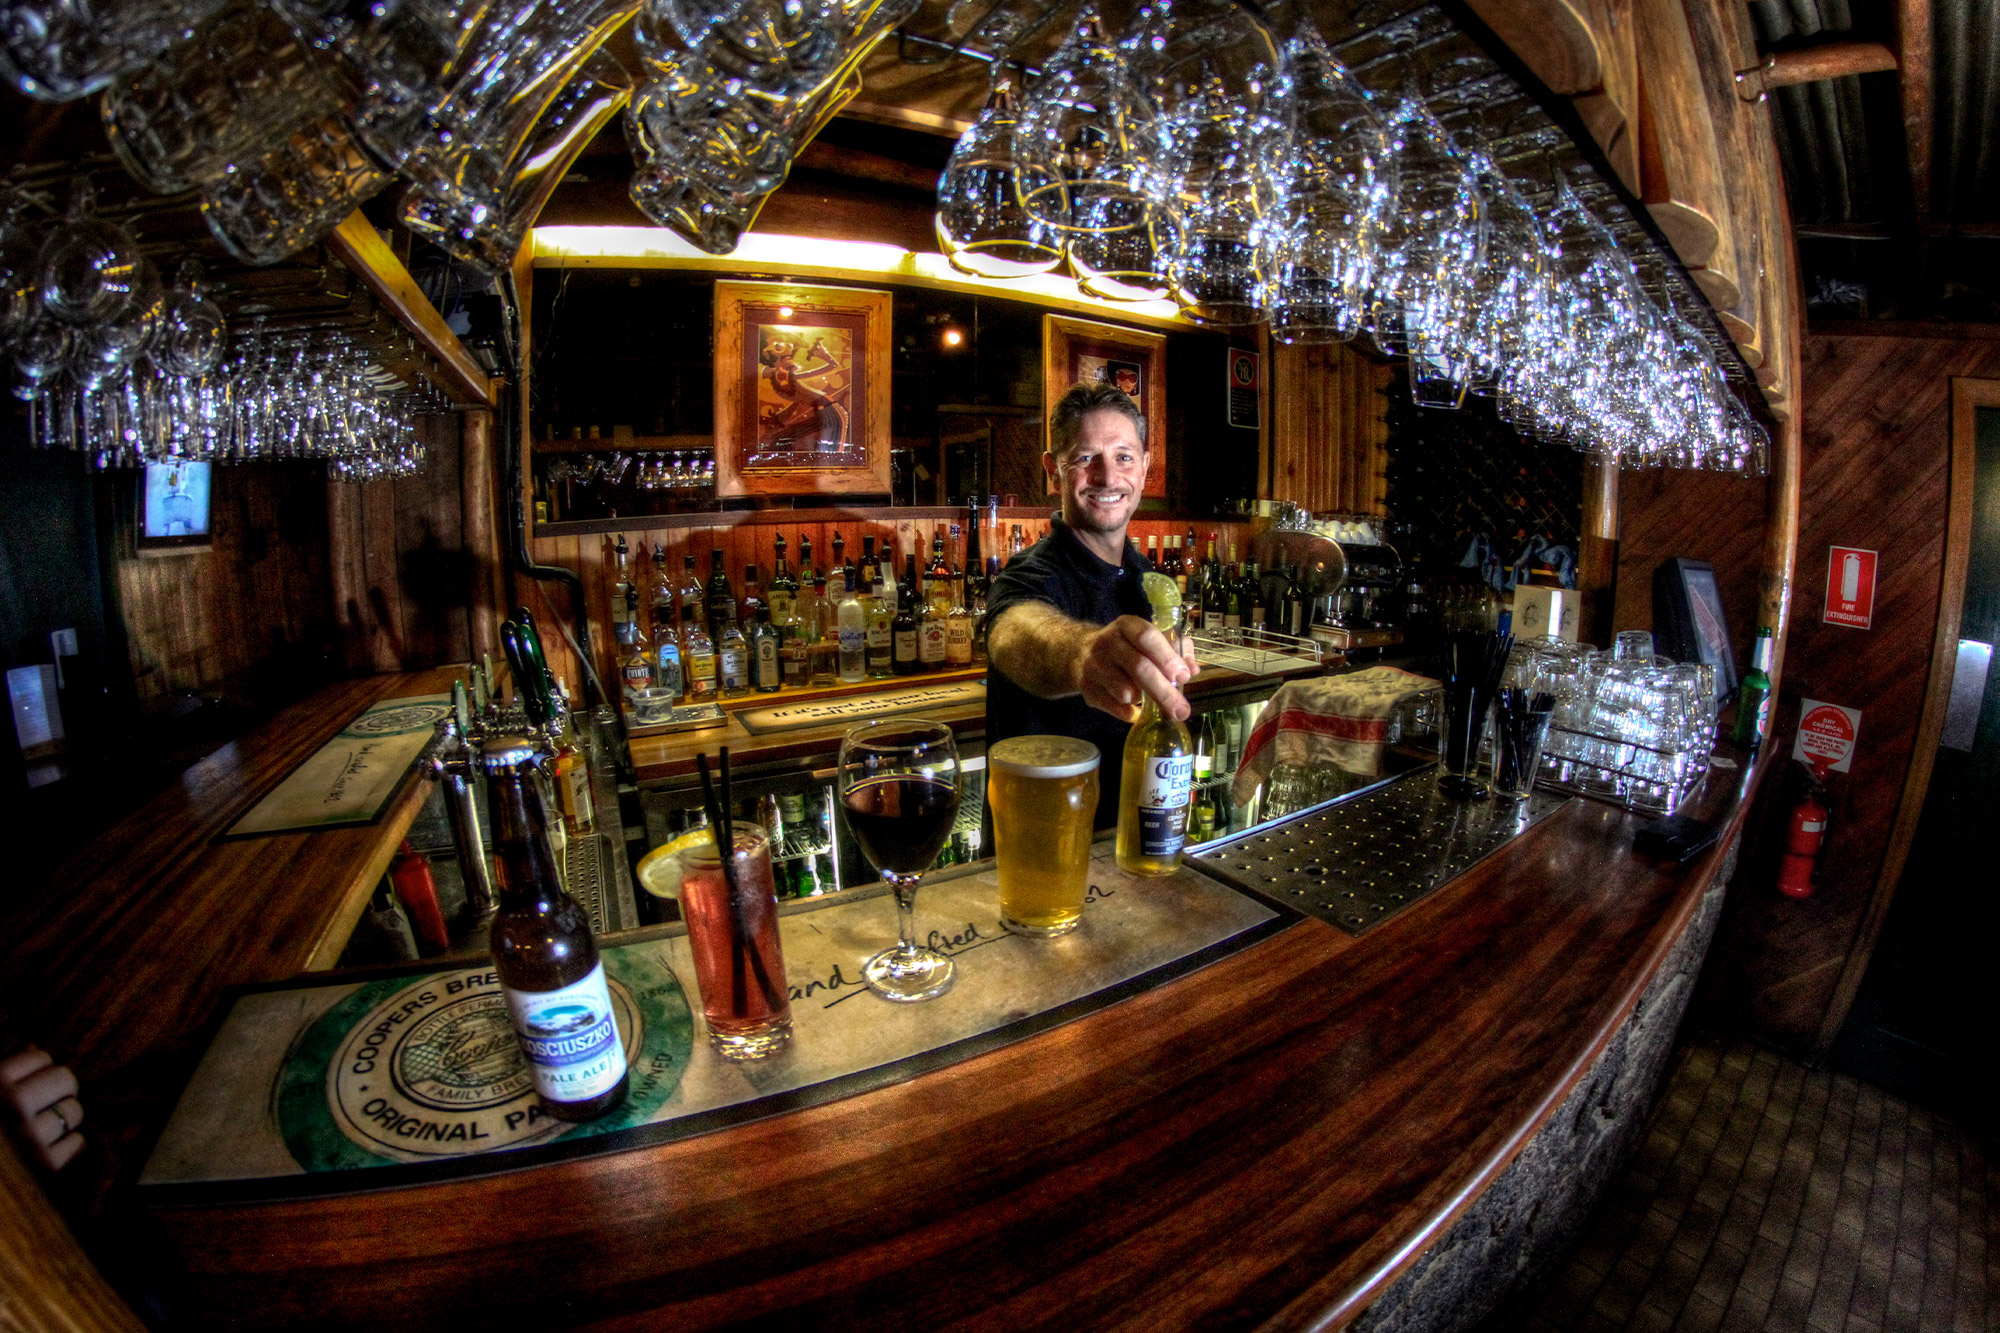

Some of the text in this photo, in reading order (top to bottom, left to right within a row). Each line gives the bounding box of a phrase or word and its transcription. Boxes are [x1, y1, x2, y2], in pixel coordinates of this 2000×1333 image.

[1842, 603, 1855, 611] FIRE
[1827, 611, 1869, 623] EXTINGUISHER
[827, 702, 858, 711] not
[1812, 721, 1844, 733] CHEMICAL
[353, 991, 439, 1075] COOPERS
[446, 972, 500, 995] BRE
[524, 1020, 613, 1058] OSCIUSZKO
[542, 1061, 607, 1083] PALE ALE
[633, 1053, 673, 1100] OWNED
[427, 1084, 486, 1101] FAMILY
[362, 1098, 490, 1143] ORIGINAL
